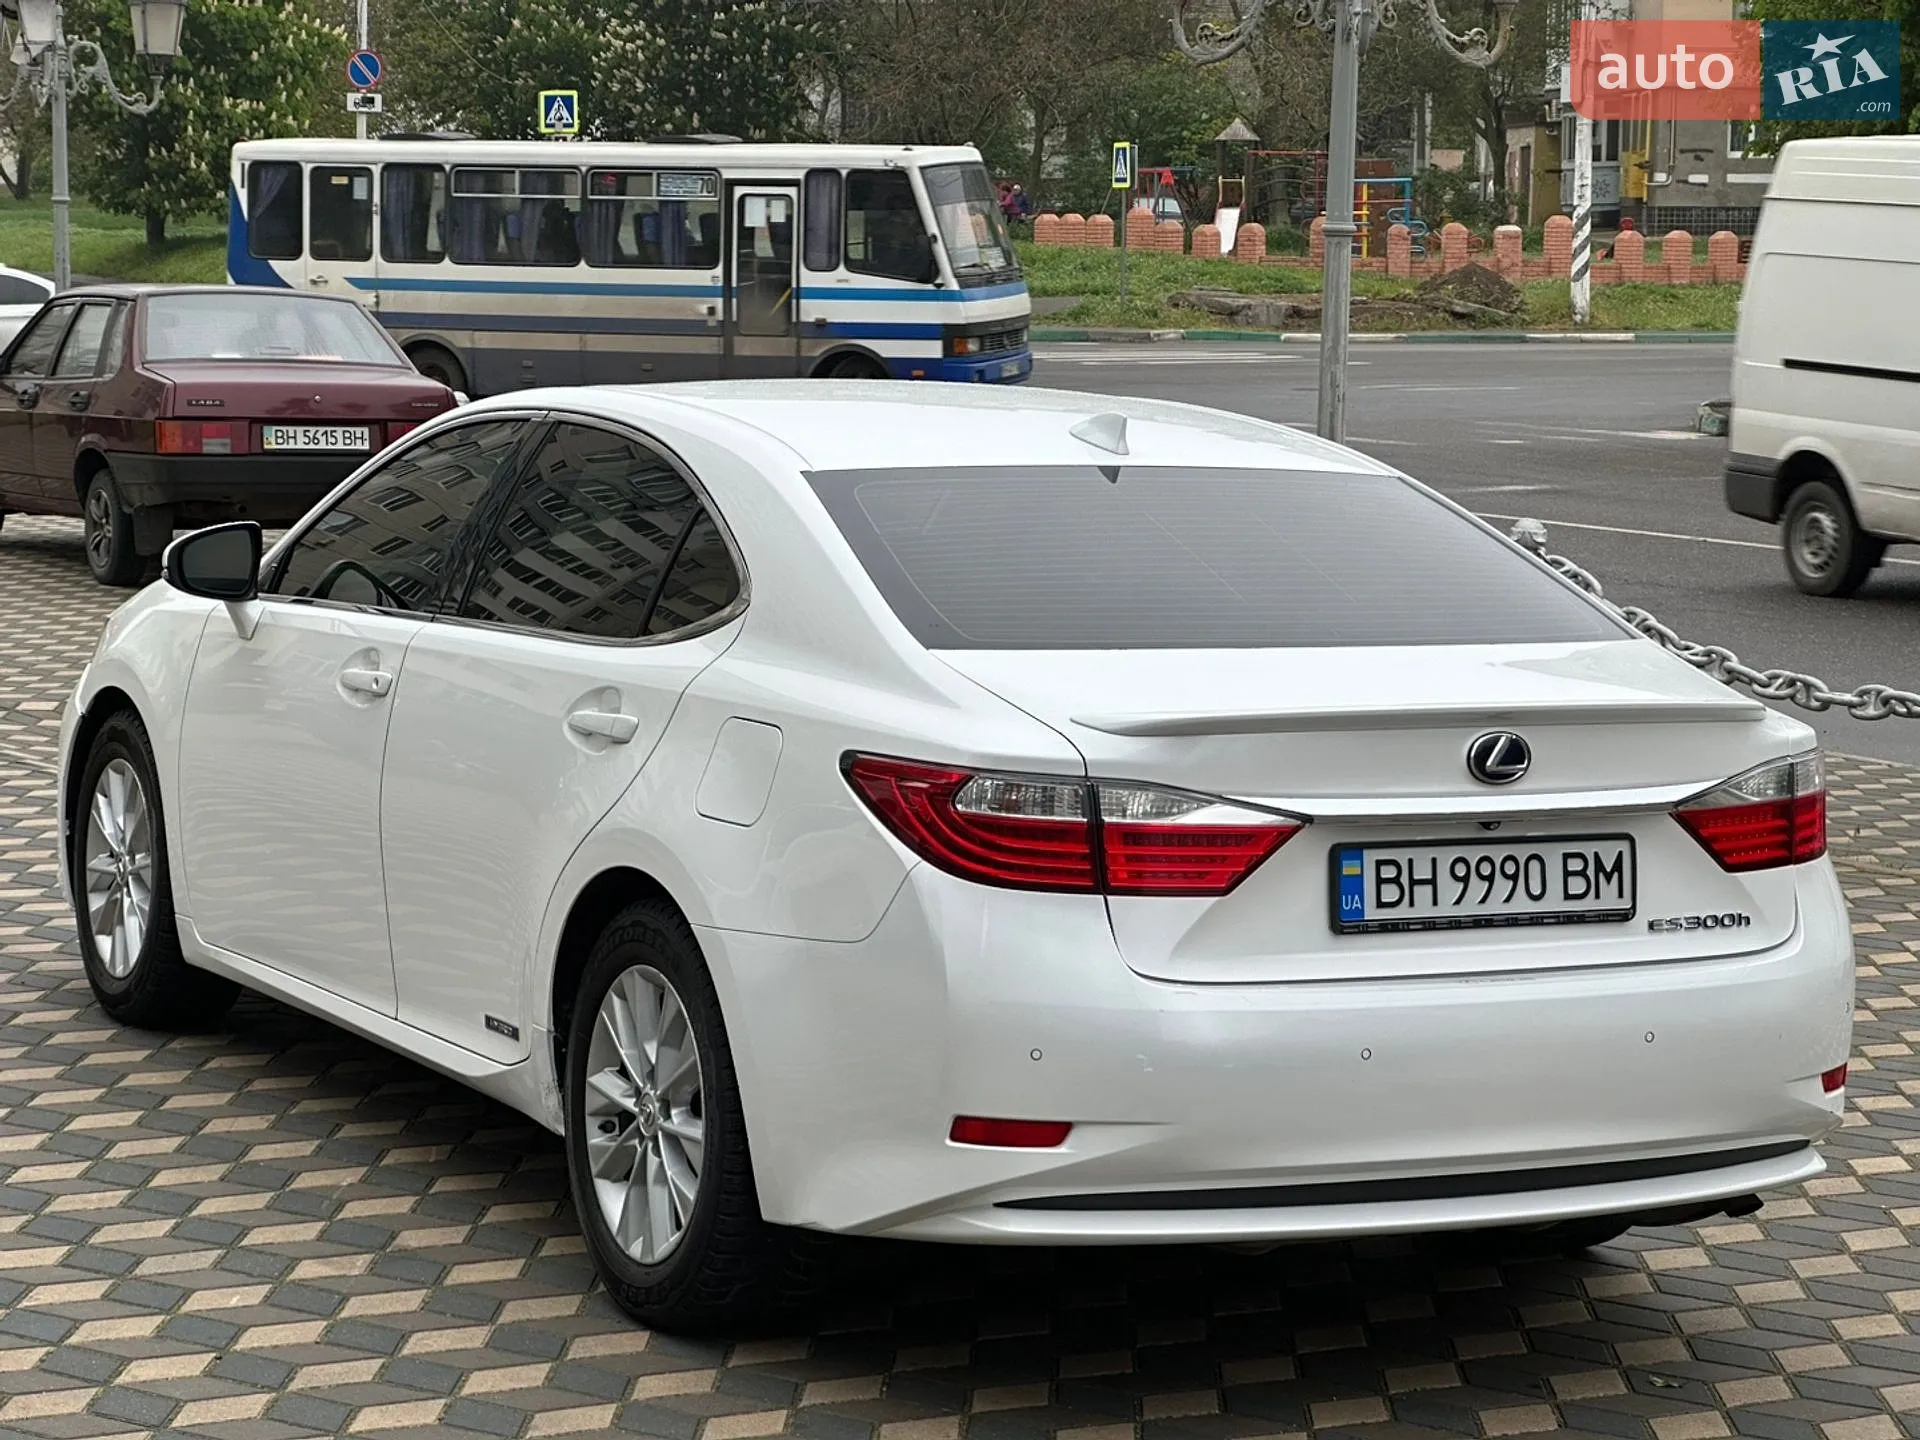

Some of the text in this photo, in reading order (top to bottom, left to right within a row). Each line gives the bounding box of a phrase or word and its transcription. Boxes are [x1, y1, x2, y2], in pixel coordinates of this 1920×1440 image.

[699, 177, 713, 194] 70
[274, 429, 365, 447] BH 5615 BH
[1374, 850, 1625, 909] BH 9990 BM
[1342, 894, 1362, 911] UA
[1647, 912, 1751, 933] ES300h
